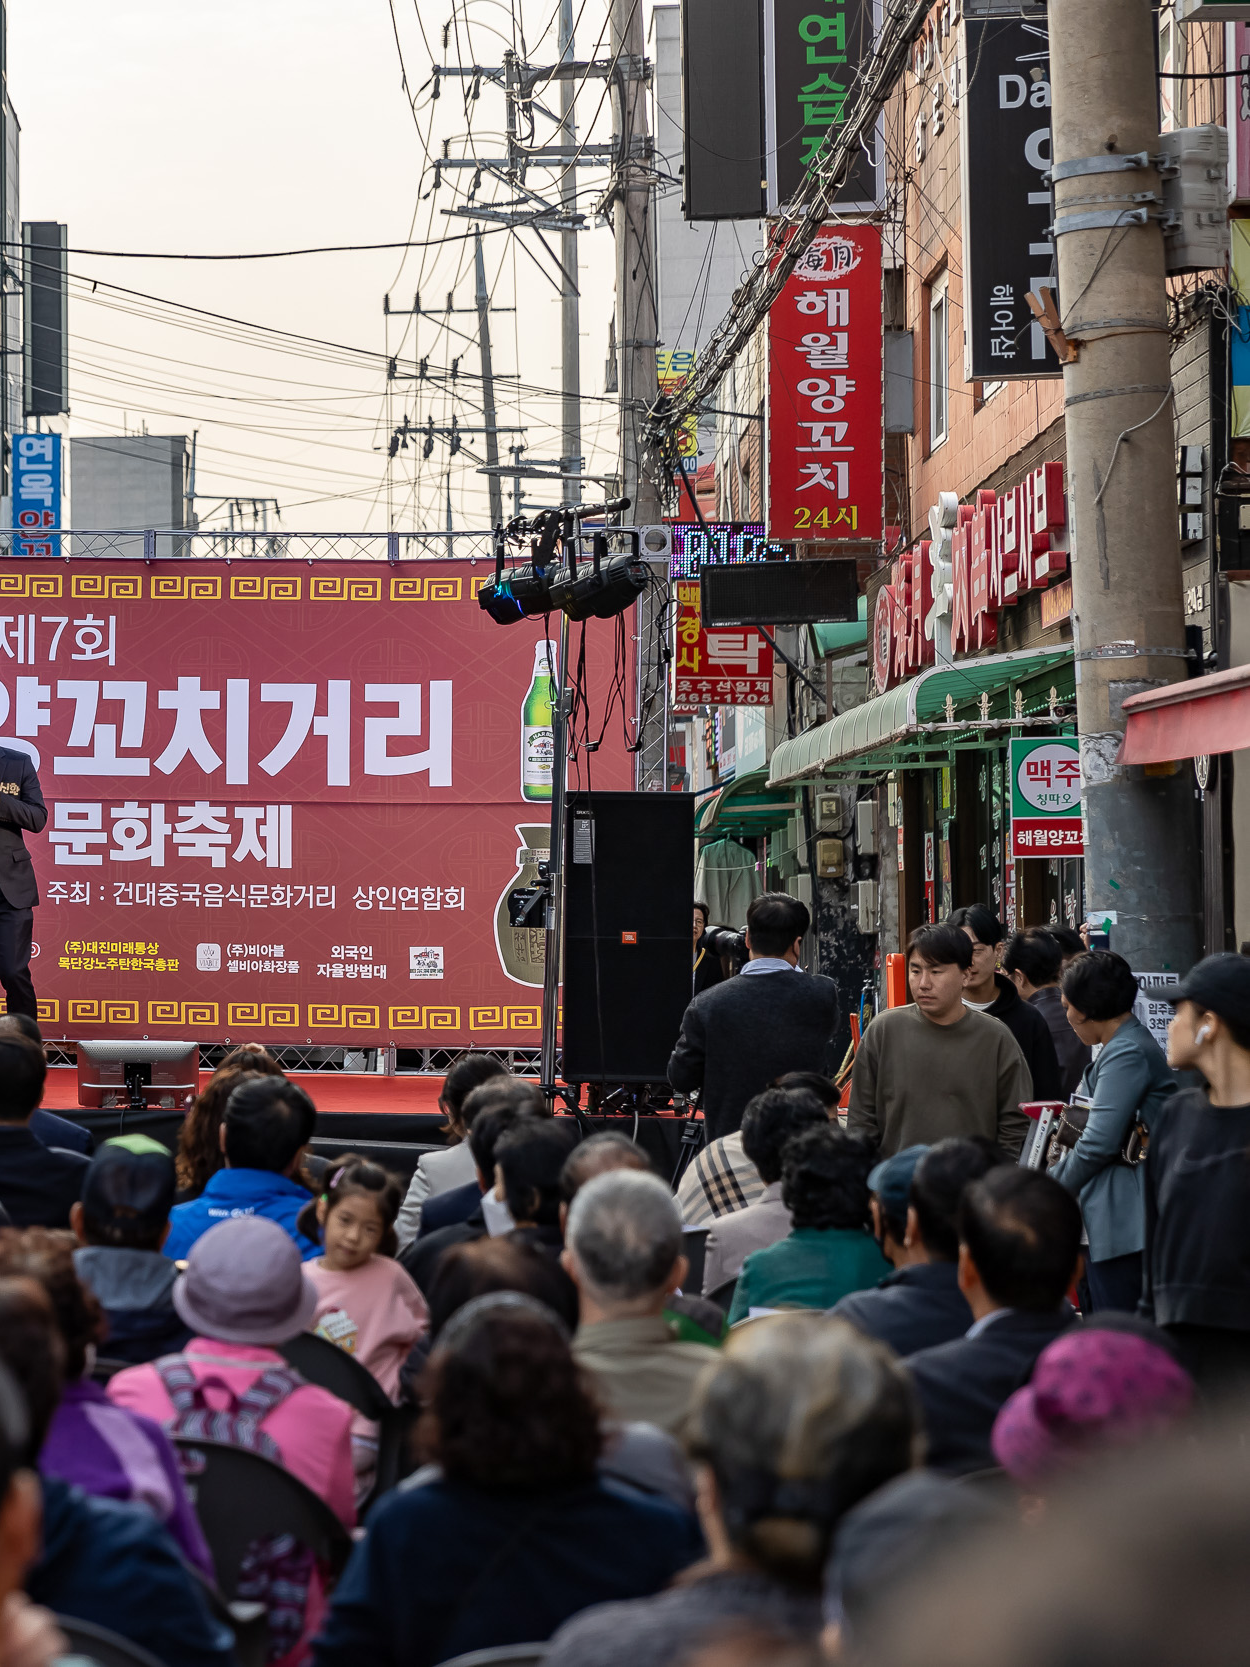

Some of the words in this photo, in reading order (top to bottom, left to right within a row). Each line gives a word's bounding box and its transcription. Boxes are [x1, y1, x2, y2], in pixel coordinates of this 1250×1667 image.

[793, 288, 857, 500] 해월양꼬치
[794, 505, 858, 531] 24시
[676, 693, 770, 704] 465-1704
[1026, 759, 1081, 789] 맥주
[1037, 793, 1073, 806] 칭따오
[48, 800, 293, 869] 문화축제
[46, 880, 91, 906] 주최
[112, 880, 336, 910] 건대중국음식문화거리
[352, 885, 466, 912] 상인연합회
[64, 940, 160, 957] (주)대진미래통상
[226, 943, 285, 958] (주)비아블
[331, 944, 373, 961] 외국인
[57, 956, 180, 973] 목단강노주탄한국총판
[226, 958, 300, 974] 셀비아화장품
[316, 962, 387, 980] 자율방범대
